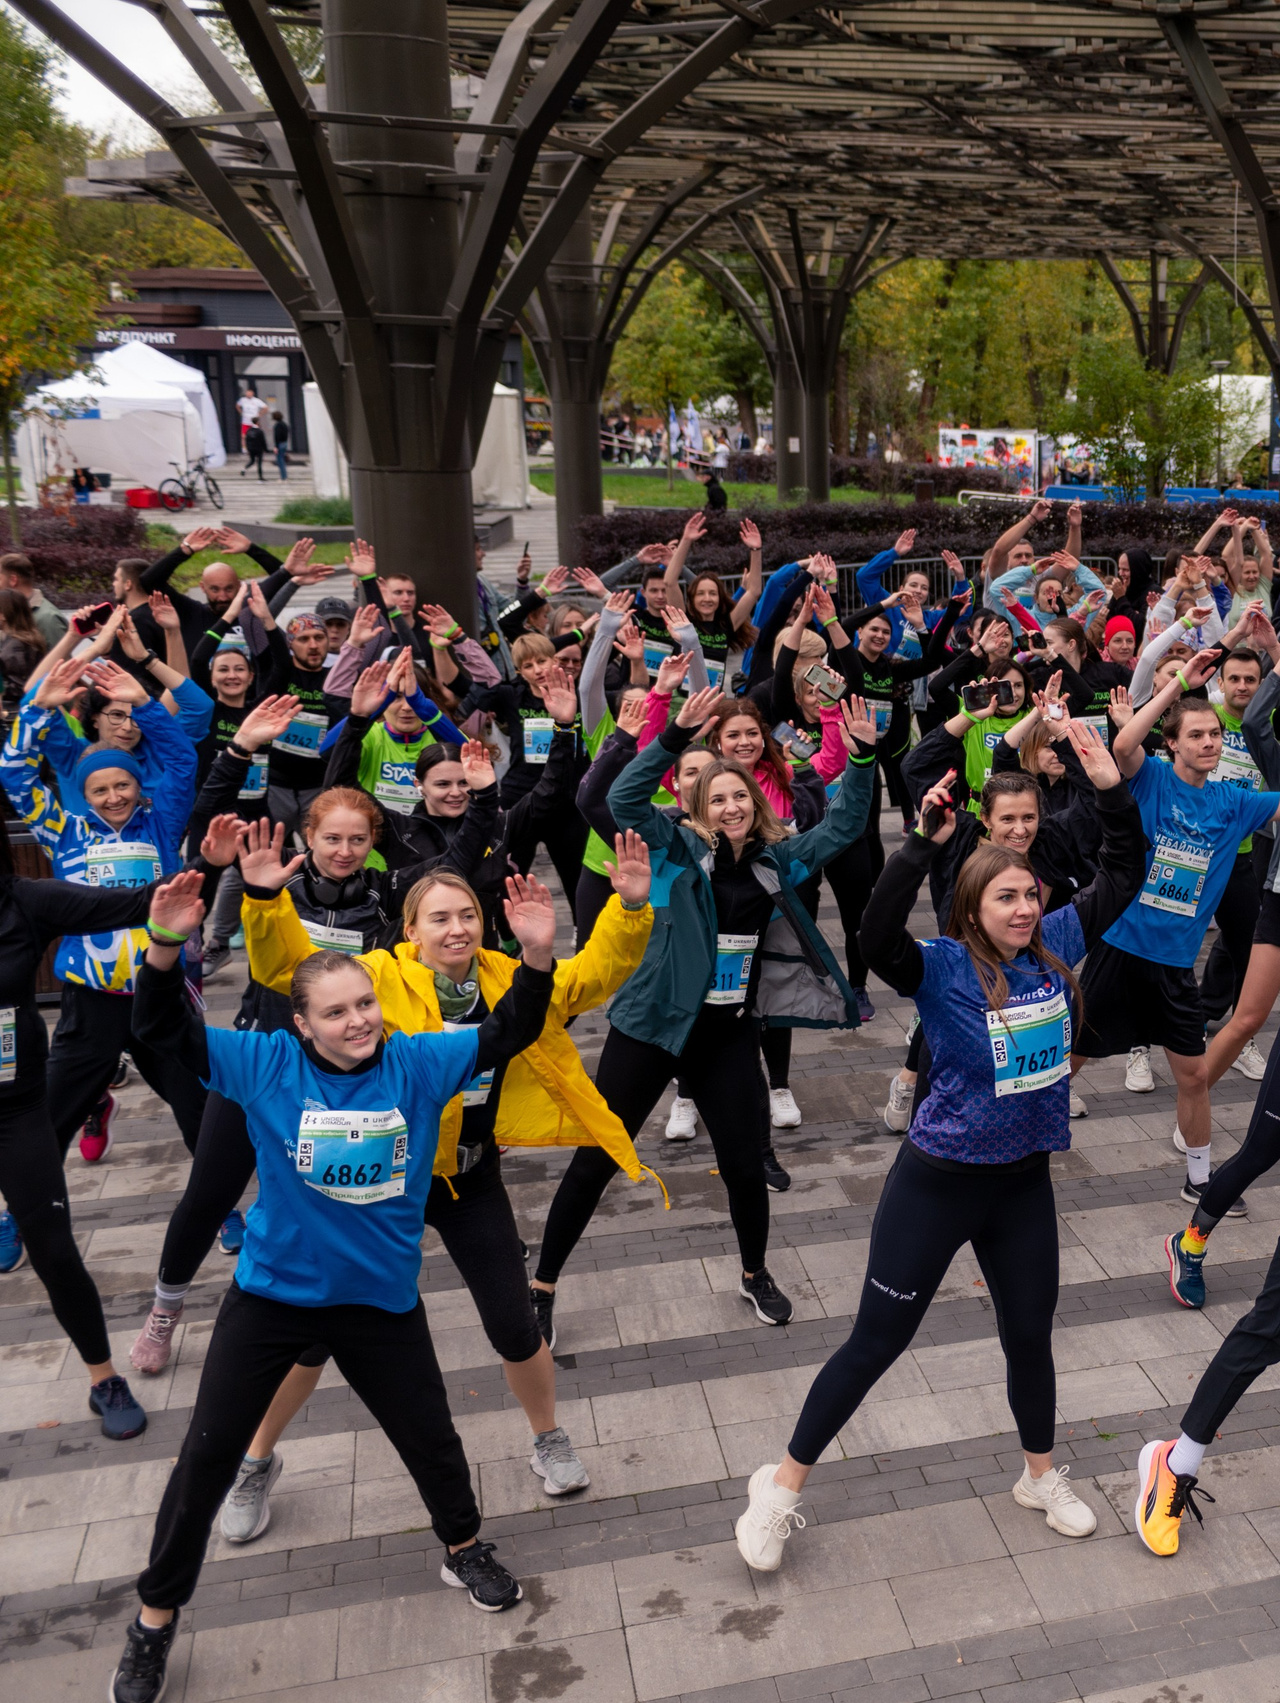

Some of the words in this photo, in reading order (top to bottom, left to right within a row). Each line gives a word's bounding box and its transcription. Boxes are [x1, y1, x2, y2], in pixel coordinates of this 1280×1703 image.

[283, 733, 312, 749] 6742
[536, 743, 549, 754] 67
[102, 865, 113, 877] A
[1164, 868, 1174, 878] C
[1158, 882, 1190, 902] 6866
[1015, 1046, 1058, 1076] 7627
[350, 1130, 360, 1139] B
[322, 1163, 383, 1186] 6862
[871, 1278, 889, 1292] moved
[889, 1288, 900, 1298] by
[899, 1292, 916, 1301] you
